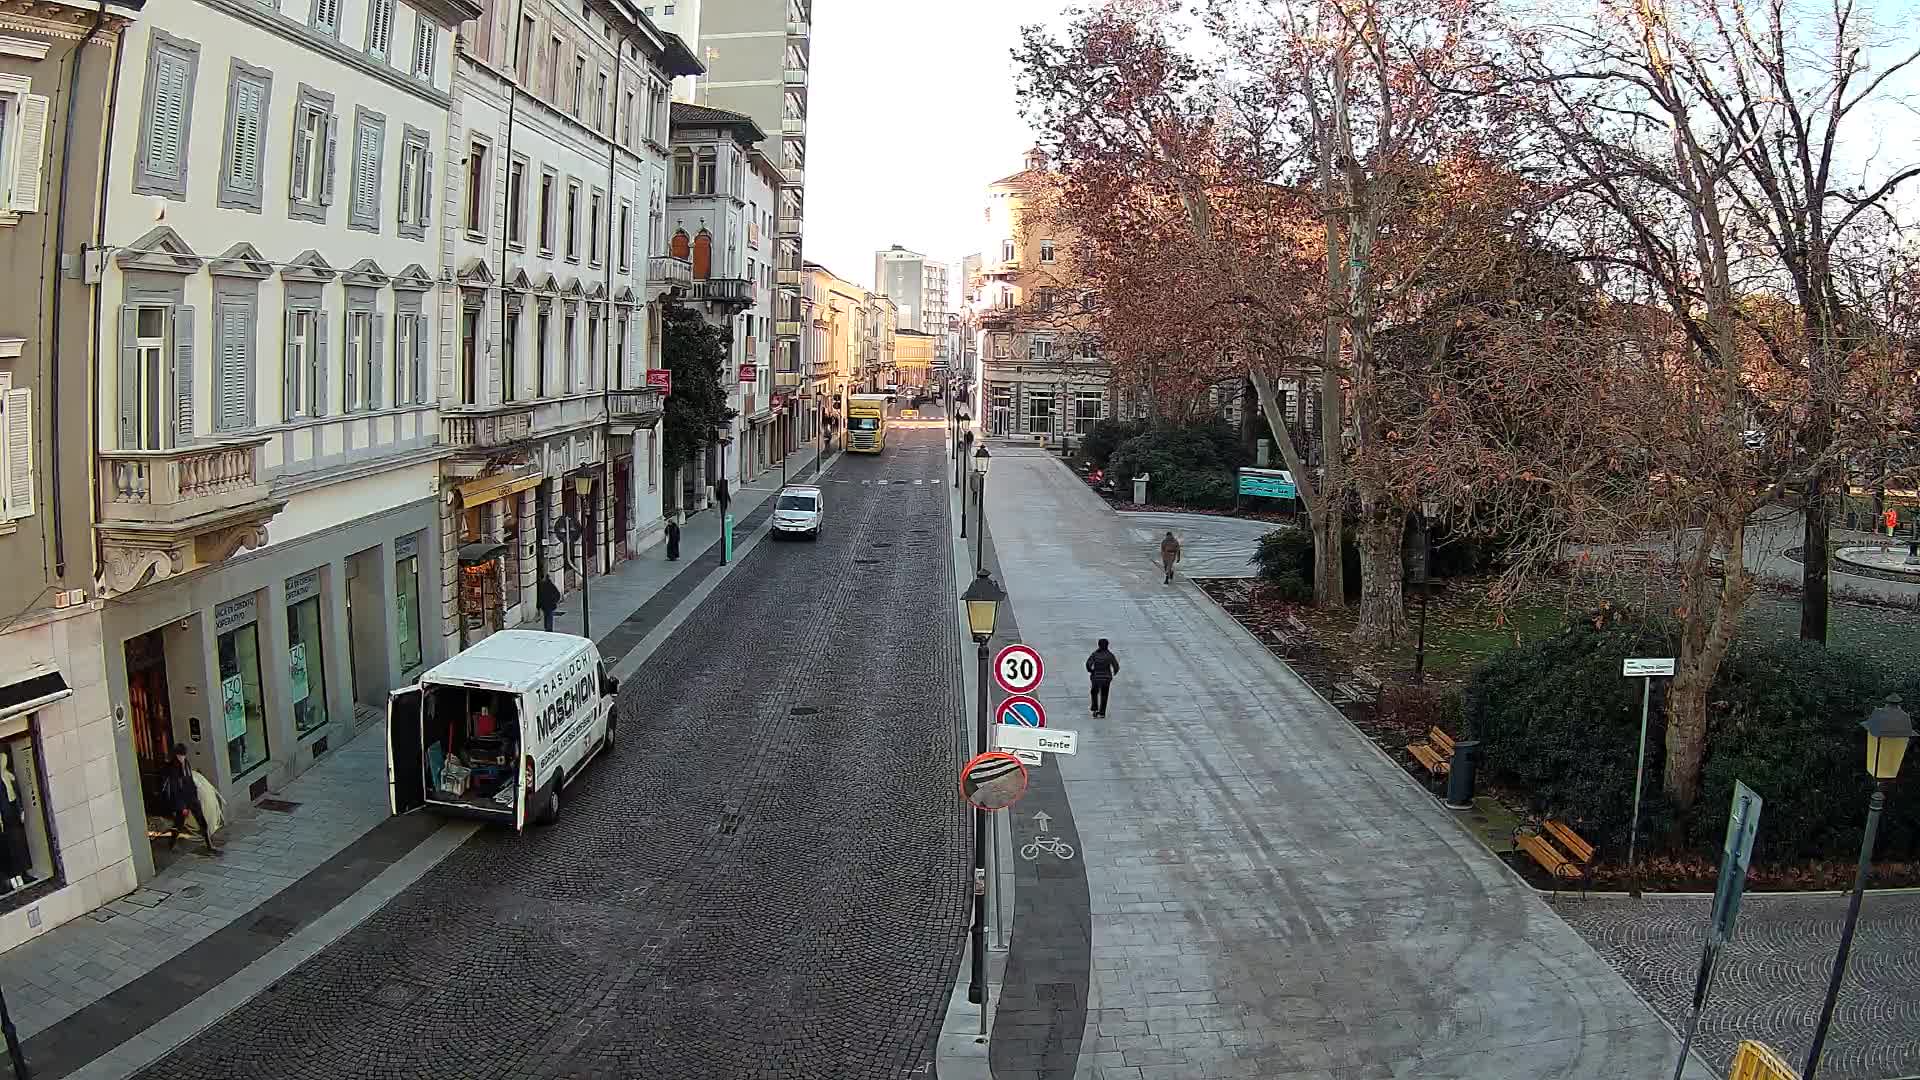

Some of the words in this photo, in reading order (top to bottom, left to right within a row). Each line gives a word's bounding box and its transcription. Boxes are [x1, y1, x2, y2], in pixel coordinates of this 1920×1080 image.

[536, 650, 591, 702] TRASLOCHI
[1006, 658, 1033, 680] 30
[536, 671, 595, 745] MOSCHION
[1038, 738, 1071, 749] Dante
